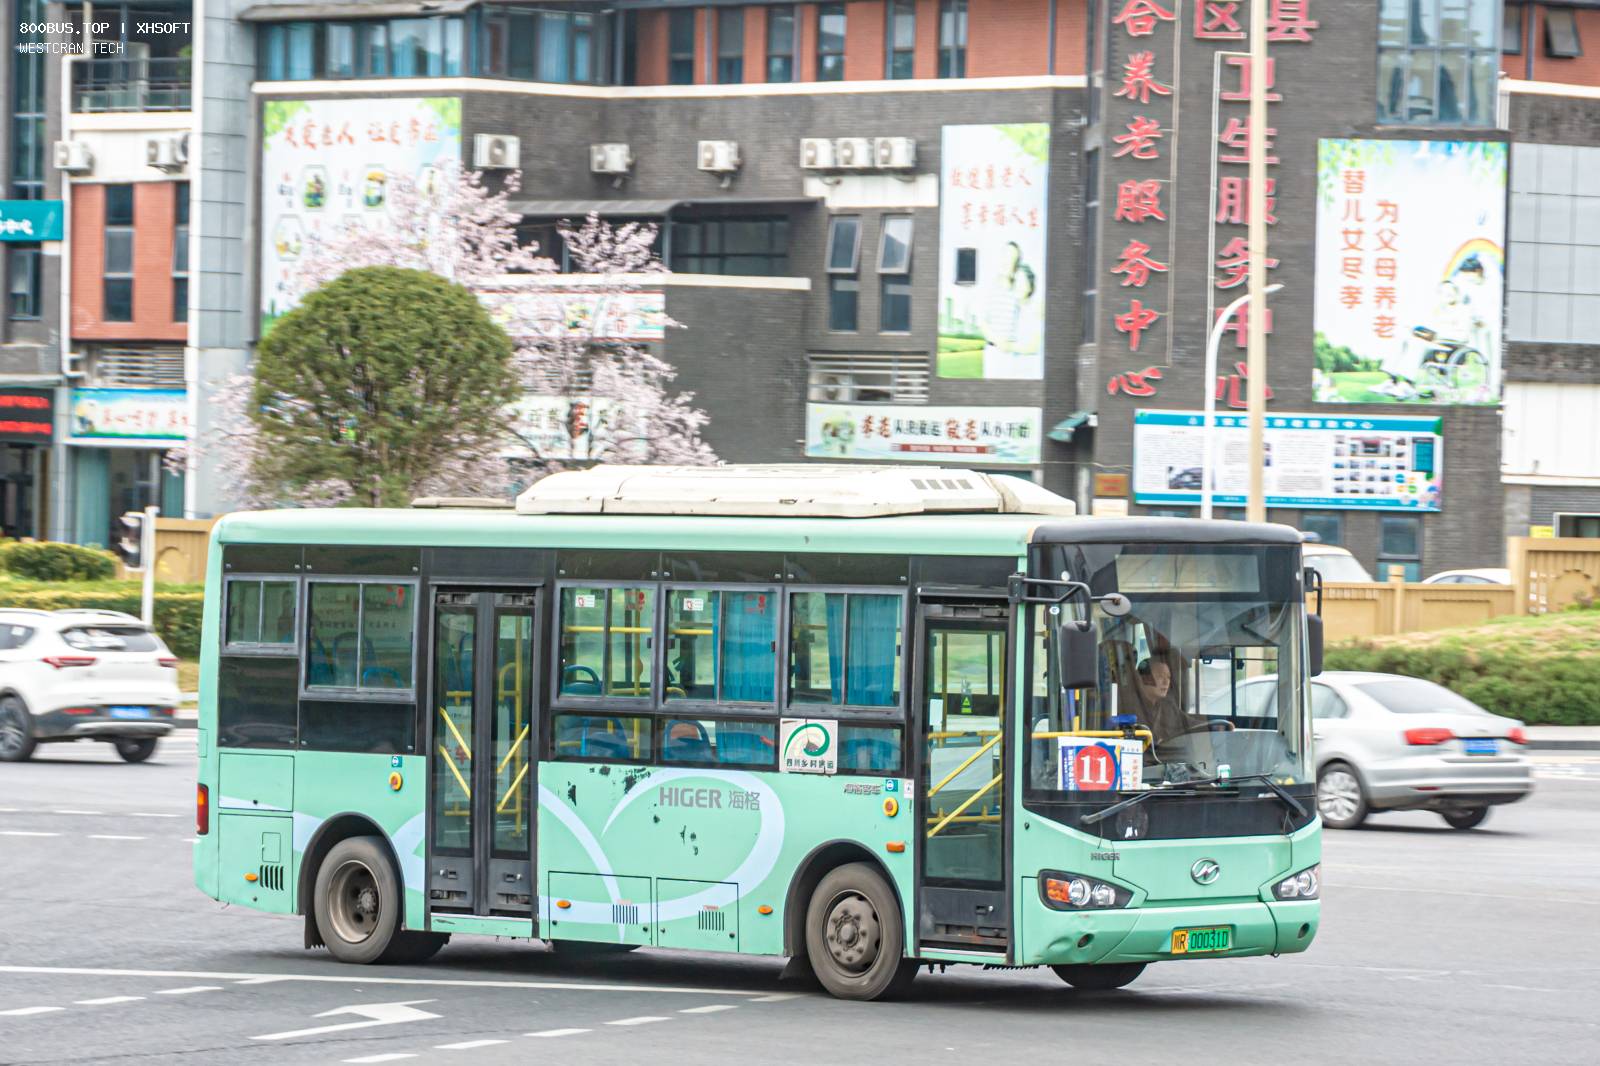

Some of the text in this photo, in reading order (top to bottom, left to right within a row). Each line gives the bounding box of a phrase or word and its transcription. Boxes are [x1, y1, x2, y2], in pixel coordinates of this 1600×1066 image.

[1339, 169, 1366, 310] 替儿女尽孝
[1373, 199, 1399, 339] 为父母养老
[660, 786, 761, 811] HIGER 海格
[1079, 754, 1110, 785] 11
